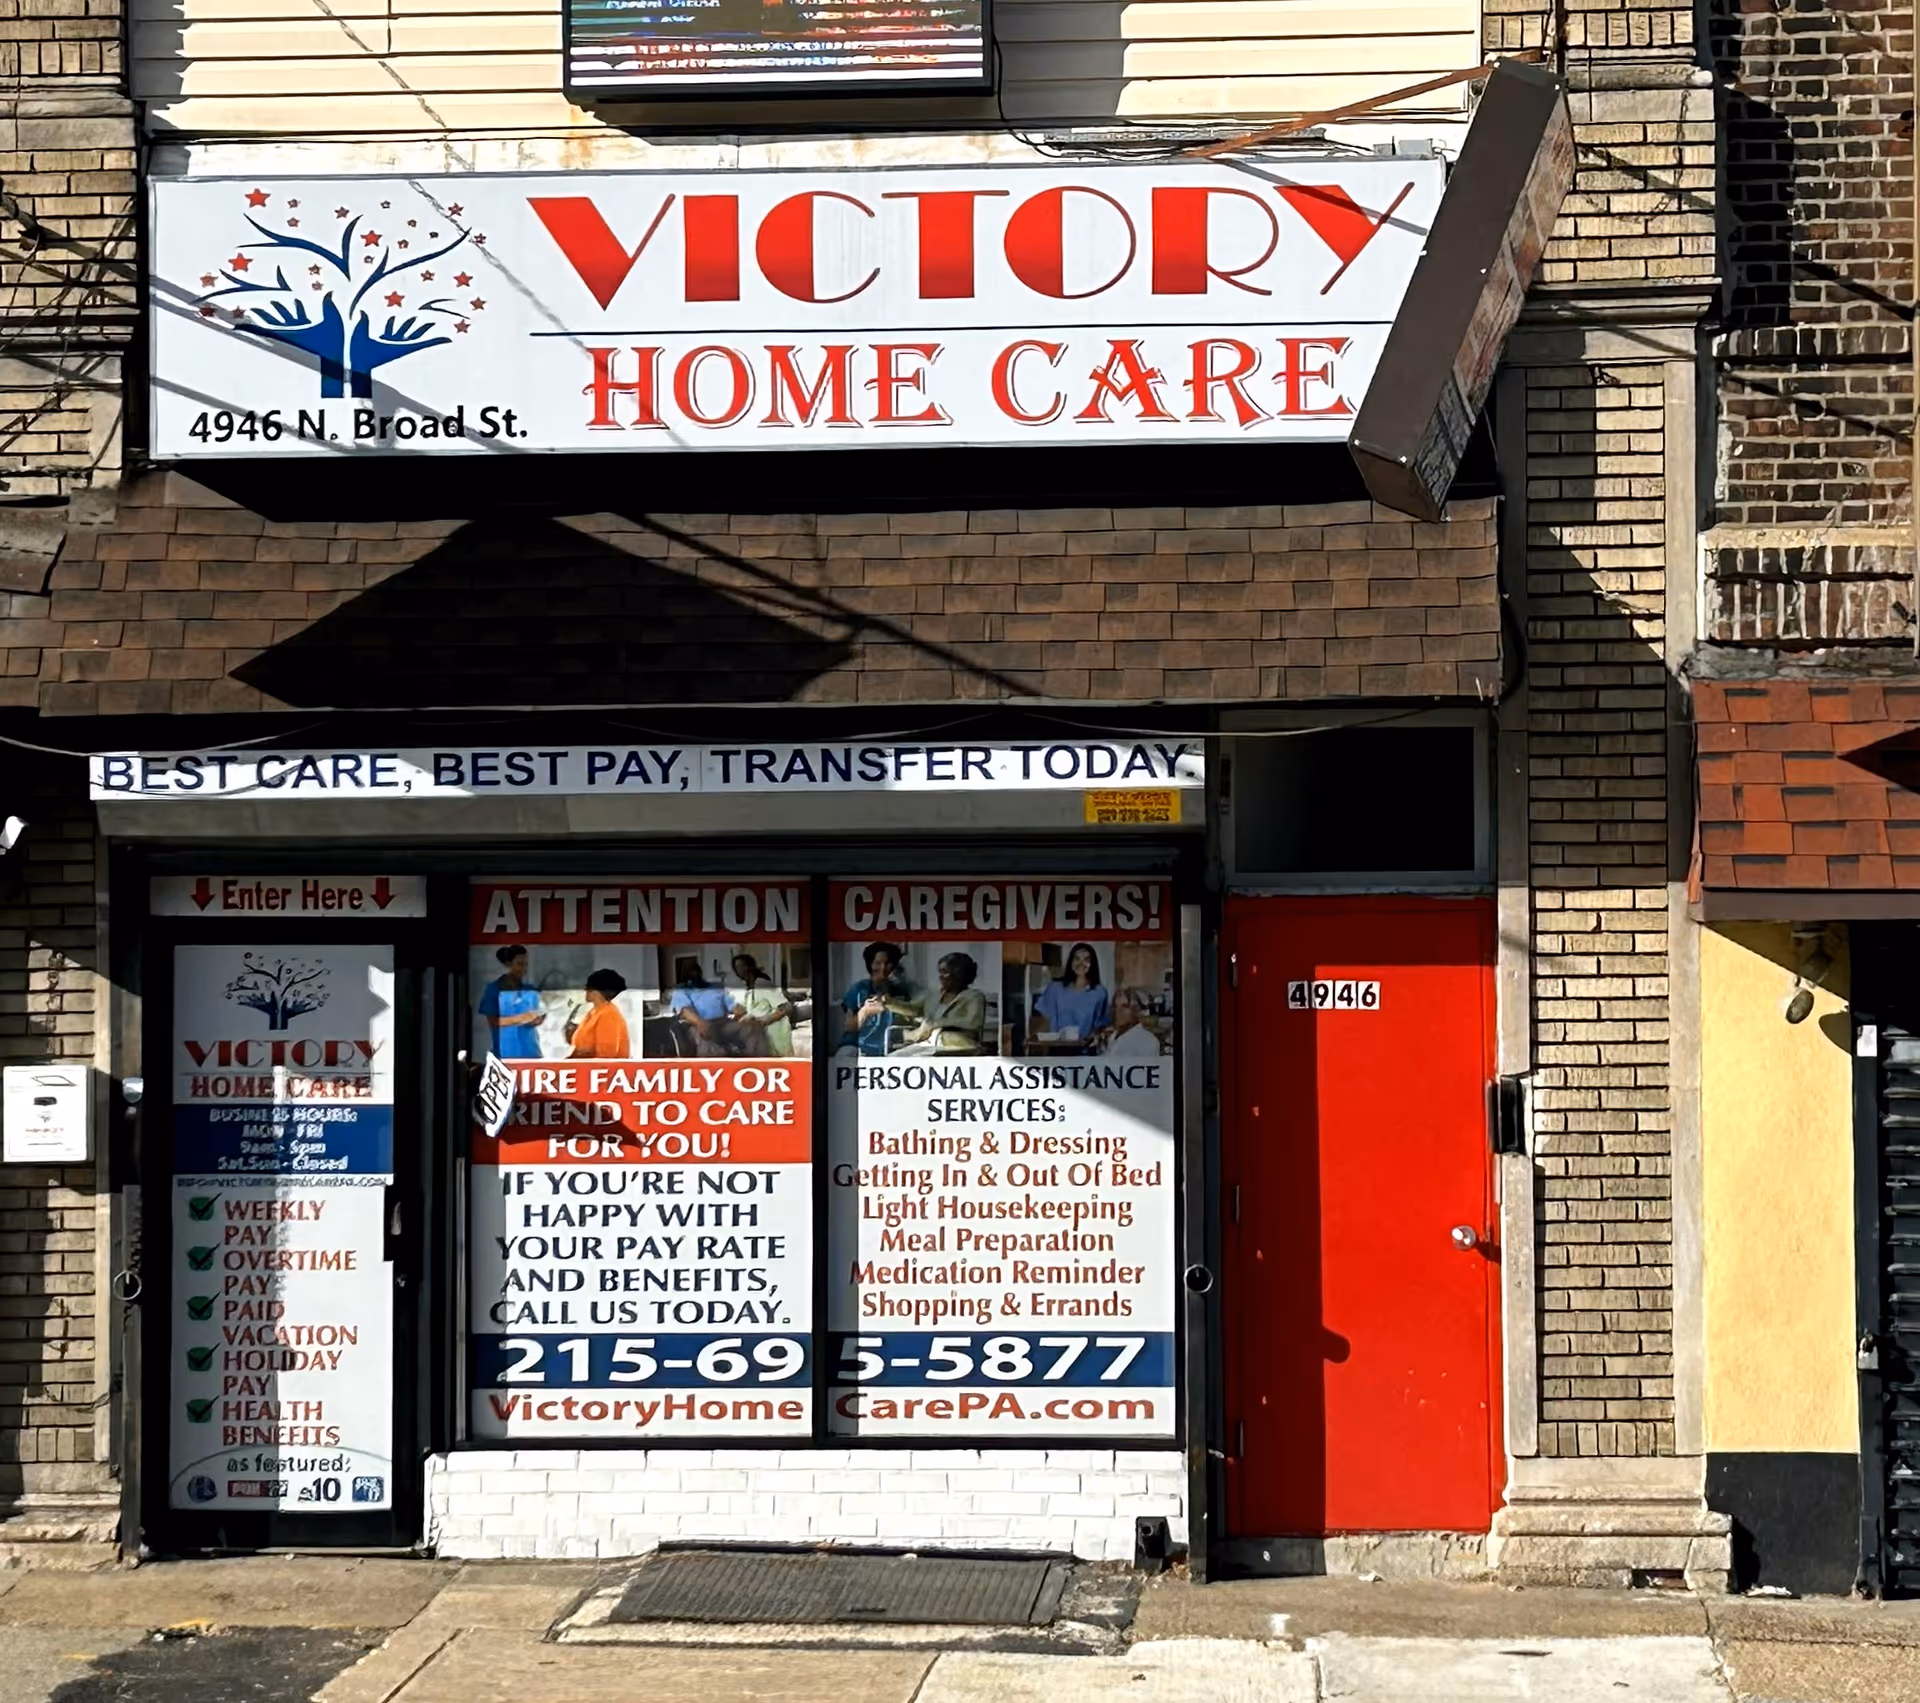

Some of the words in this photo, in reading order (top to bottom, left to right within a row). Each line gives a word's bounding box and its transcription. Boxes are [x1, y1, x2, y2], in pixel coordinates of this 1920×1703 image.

[526, 182, 1415, 311] VICTORY
[582, 343, 954, 430] HOME
[991, 337, 1358, 430] CARE
[189, 409, 282, 442] 4946
[299, 409, 338, 440] N.
[354, 406, 465, 439] Broad
[479, 406, 527, 438] St.
[103, 755, 237, 790] BEST
[256, 753, 412, 793] CARE,
[433, 751, 568, 787] BEST
[587, 749, 689, 790] PAY,
[710, 746, 993, 784] TRANSFER
[223, 880, 291, 910] Enter
[302, 880, 364, 910] Here
[844, 884, 1160, 931] CAREGIVERS!
[482, 888, 799, 933] ATTENTION
[1290, 983, 1376, 1007] 4946
[183, 1039, 386, 1068] VICTORY
[190, 1076, 274, 1098] HOME
[287, 1076, 373, 1098] CARE
[589, 1068, 723, 1093] FAMILY
[733, 1068, 790, 1093] OR
[836, 1066, 981, 1090] PERSONAL
[989, 1065, 1159, 1089] ASSISTANCE
[508, 1100, 621, 1125] RIEND
[632, 1100, 687, 1125] TO
[700, 1100, 794, 1124] CARE
[928, 1099, 1065, 1122] SERVICES:
[548, 1134, 624, 1158] FOR
[637, 1133, 730, 1158] YOU!
[869, 1129, 971, 1162] Bathing
[980, 1131, 999, 1155] &
[1010, 1128, 1127, 1161] Dressing
[503, 1171, 534, 1195] IF
[546, 1171, 684, 1195] YOU'RE
[698, 1171, 780, 1194] NOT
[833, 1161, 933, 1194] Getting
[943, 1164, 967, 1186] In
[977, 1164, 997, 1186] &
[1007, 1164, 1059, 1186] Out
[1068, 1161, 1101, 1186] Of
[1112, 1161, 1161, 1186] Bed
[224, 1200, 326, 1220] WEEKLY
[523, 1203, 645, 1227] HAPPY
[656, 1204, 757, 1227] WITH
[863, 1193, 928, 1227] Light
[938, 1194, 1133, 1231] Housekeeping
[224, 1226, 272, 1245] PAY
[496, 1236, 603, 1260] YOUR
[617, 1235, 685, 1259] PAY
[698, 1236, 785, 1258] RATE
[880, 1226, 945, 1251] Meal
[956, 1228, 1114, 1259] Preparation
[223, 1250, 356, 1270] OVERTIME
[850, 1258, 1001, 1284] Medication
[1012, 1258, 1145, 1284] Reminder
[224, 1276, 271, 1296] PAY
[502, 1269, 585, 1292] AND
[600, 1268, 777, 1297] BENEFITS,
[224, 1301, 285, 1321] PAID
[490, 1301, 577, 1324] CALL
[590, 1301, 637, 1324] US
[651, 1300, 790, 1324] TODAY.
[862, 1290, 992, 1325] Shopping
[1000, 1292, 1020, 1316] &
[1031, 1291, 1132, 1316] Errands
[222, 1326, 358, 1345] VACATION
[224, 1350, 343, 1371] HOLIDAY
[497, 1338, 804, 1382] 215-69
[838, 1336, 1146, 1381] 5-5877
[223, 1376, 269, 1396] PAY
[222, 1401, 323, 1420] HEALTH
[489, 1394, 804, 1428] VictoryHome
[836, 1393, 1155, 1420] CarePA.com
[222, 1426, 340, 1446] BENEFITS
[227, 1457, 249, 1472] as
[313, 1477, 341, 1501] 10
